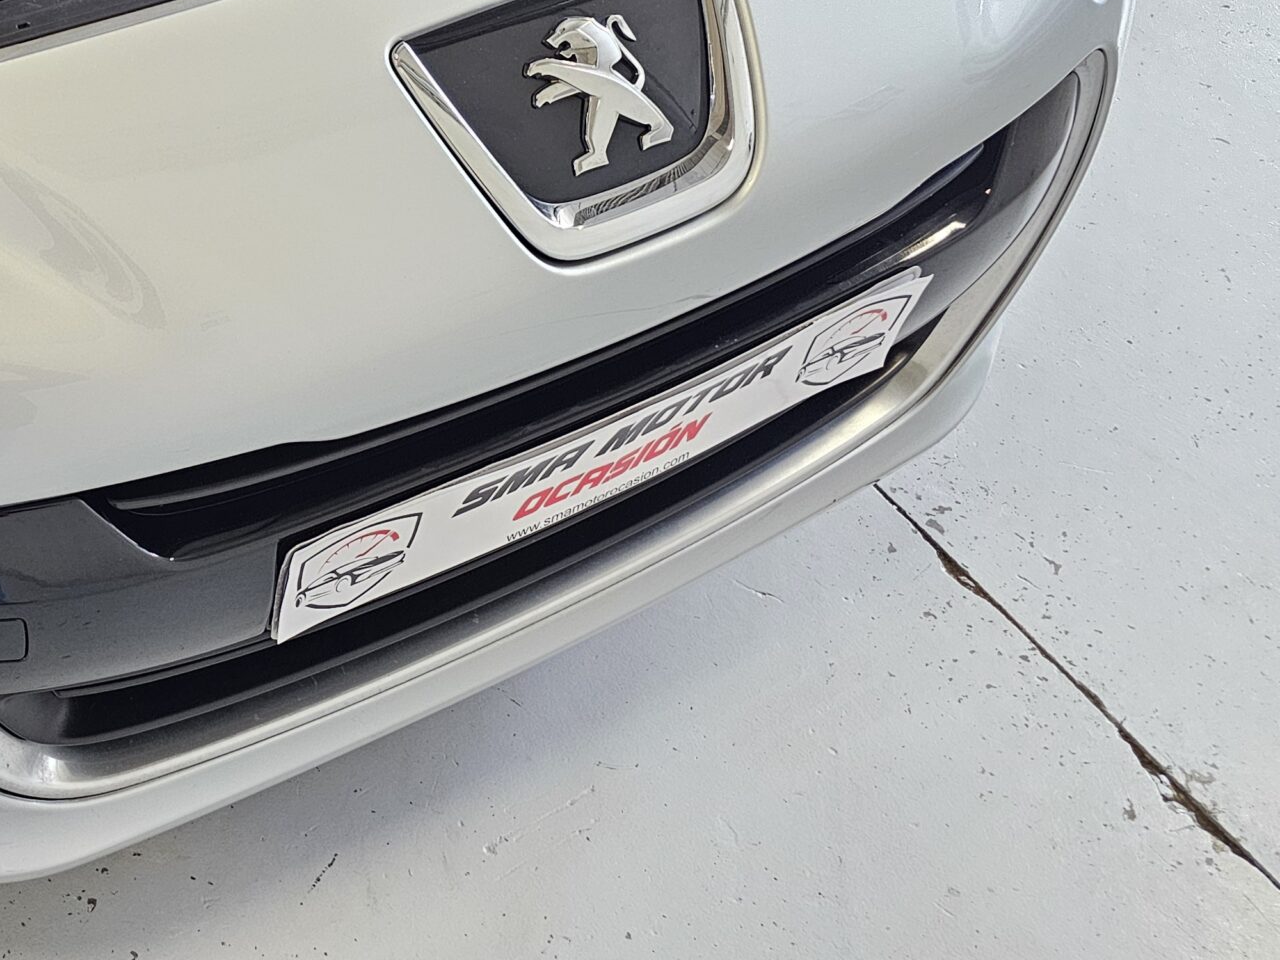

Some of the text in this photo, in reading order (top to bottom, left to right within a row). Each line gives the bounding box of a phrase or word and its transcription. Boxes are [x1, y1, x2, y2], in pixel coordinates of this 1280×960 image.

[451, 344, 794, 518] SMA MOTOR
[511, 411, 713, 521] OCASIÓN
[505, 450, 690, 542] www.smamotorocasion.com
